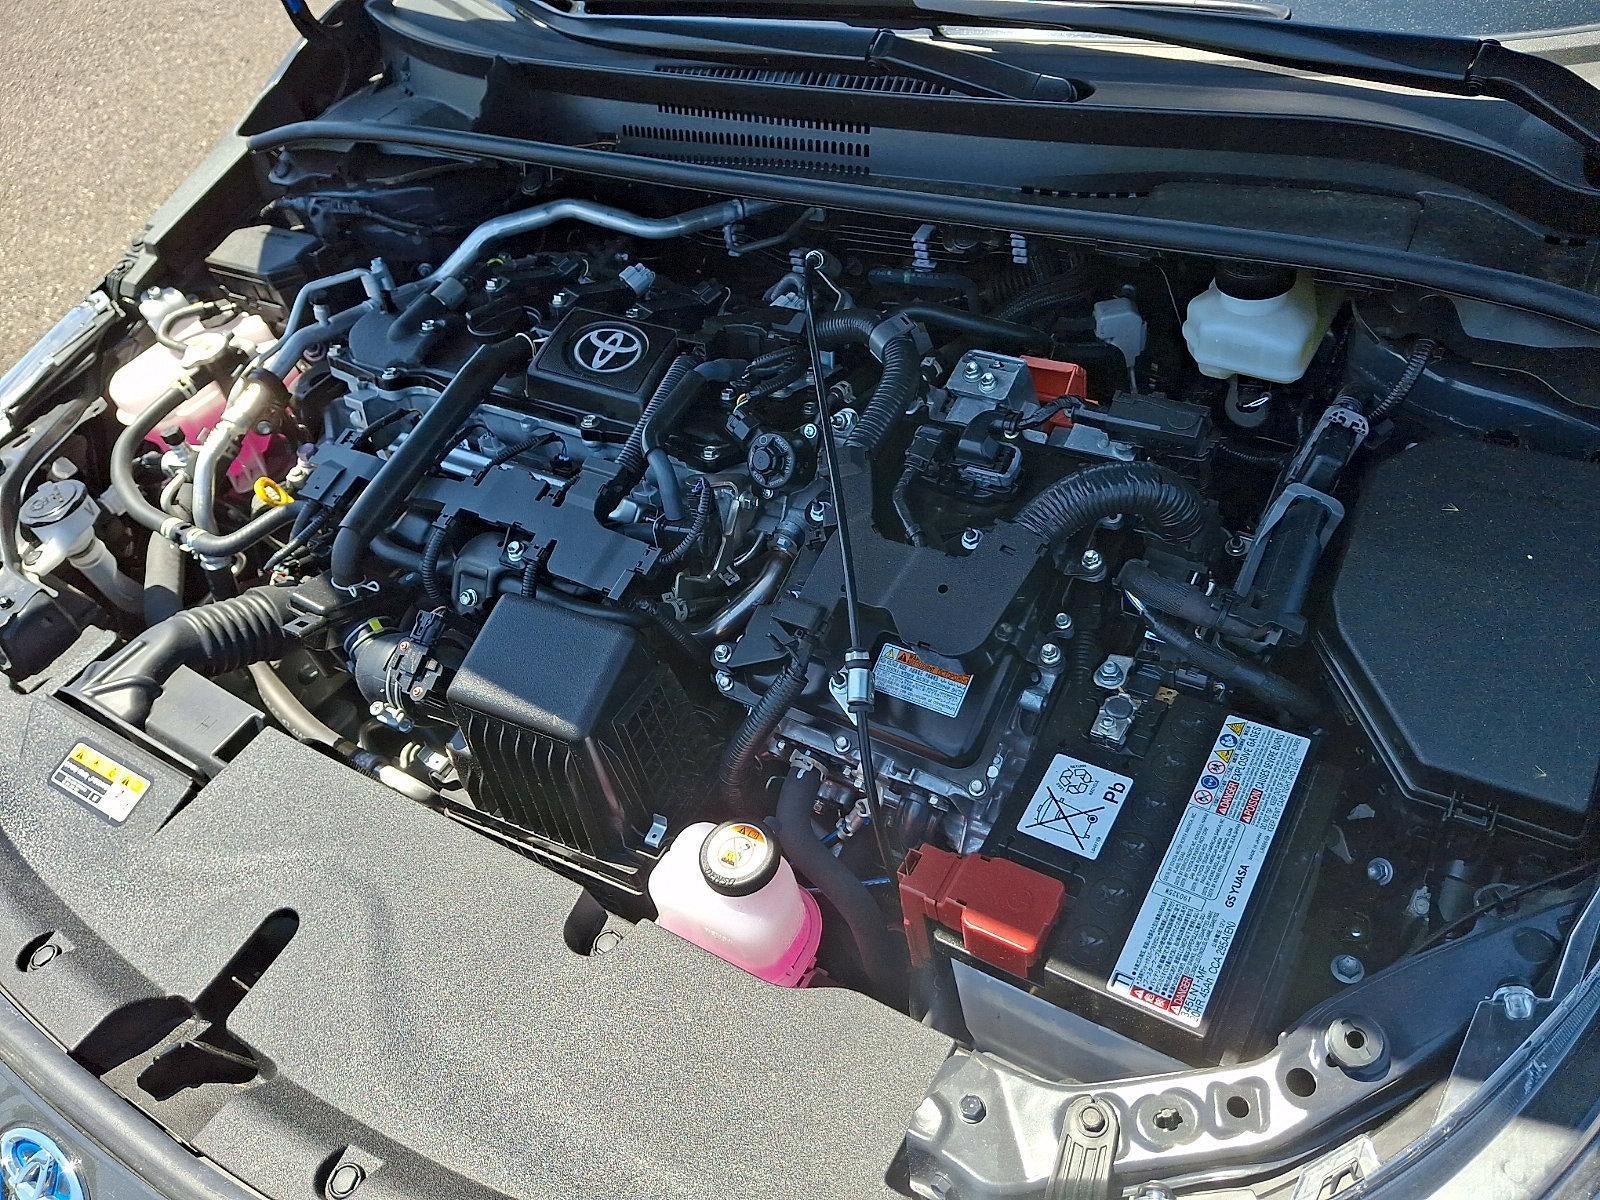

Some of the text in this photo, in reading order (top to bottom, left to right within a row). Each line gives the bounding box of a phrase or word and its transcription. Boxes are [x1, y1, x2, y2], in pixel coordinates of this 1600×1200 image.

[1270, 732, 1285, 750] BURNS
[1219, 781, 1238, 808] DANGER
[1230, 746, 1253, 782] EXPLOSIVE
[1245, 725, 1262, 747] GASES
[1262, 748, 1278, 769] SEVERE
[1254, 767, 1271, 789] CAUSES
[1102, 782, 1126, 804] Pb
[1243, 789, 1262, 816] POISON
[704, 868, 736, 886] DENSO
[1228, 862, 1250, 896] YUASA
[1223, 893, 1237, 909] GS
[1198, 975, 1214, 999] 45Ah
[1207, 954, 1223, 975] CCA
[1215, 919, 1237, 956] 295A(EN)
[1172, 974, 1192, 1005] DANGER
